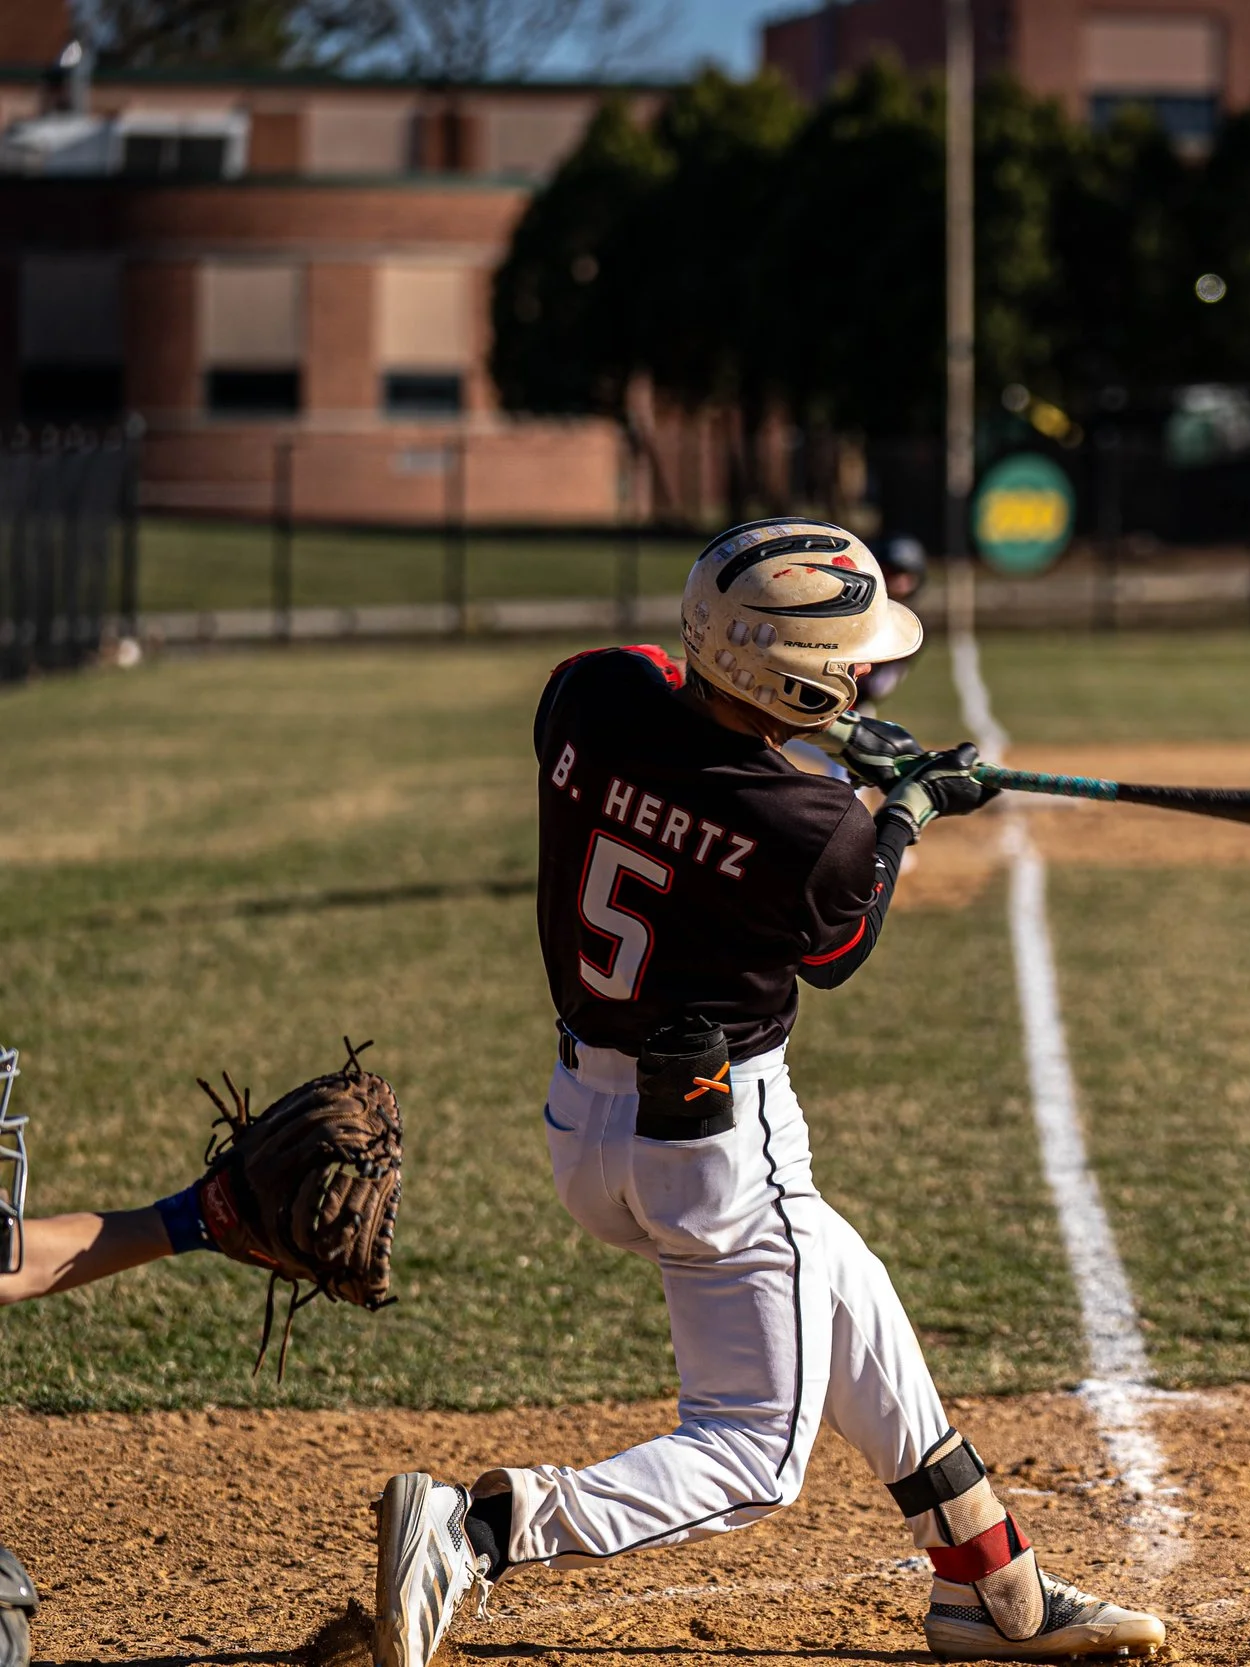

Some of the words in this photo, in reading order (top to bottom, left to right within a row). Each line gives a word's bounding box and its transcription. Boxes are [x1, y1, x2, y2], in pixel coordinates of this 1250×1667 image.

[783, 640, 839, 650] RAWLINGS
[551, 741, 580, 800] B.
[603, 777, 757, 879] HERTZ
[578, 829, 675, 1000] 5
